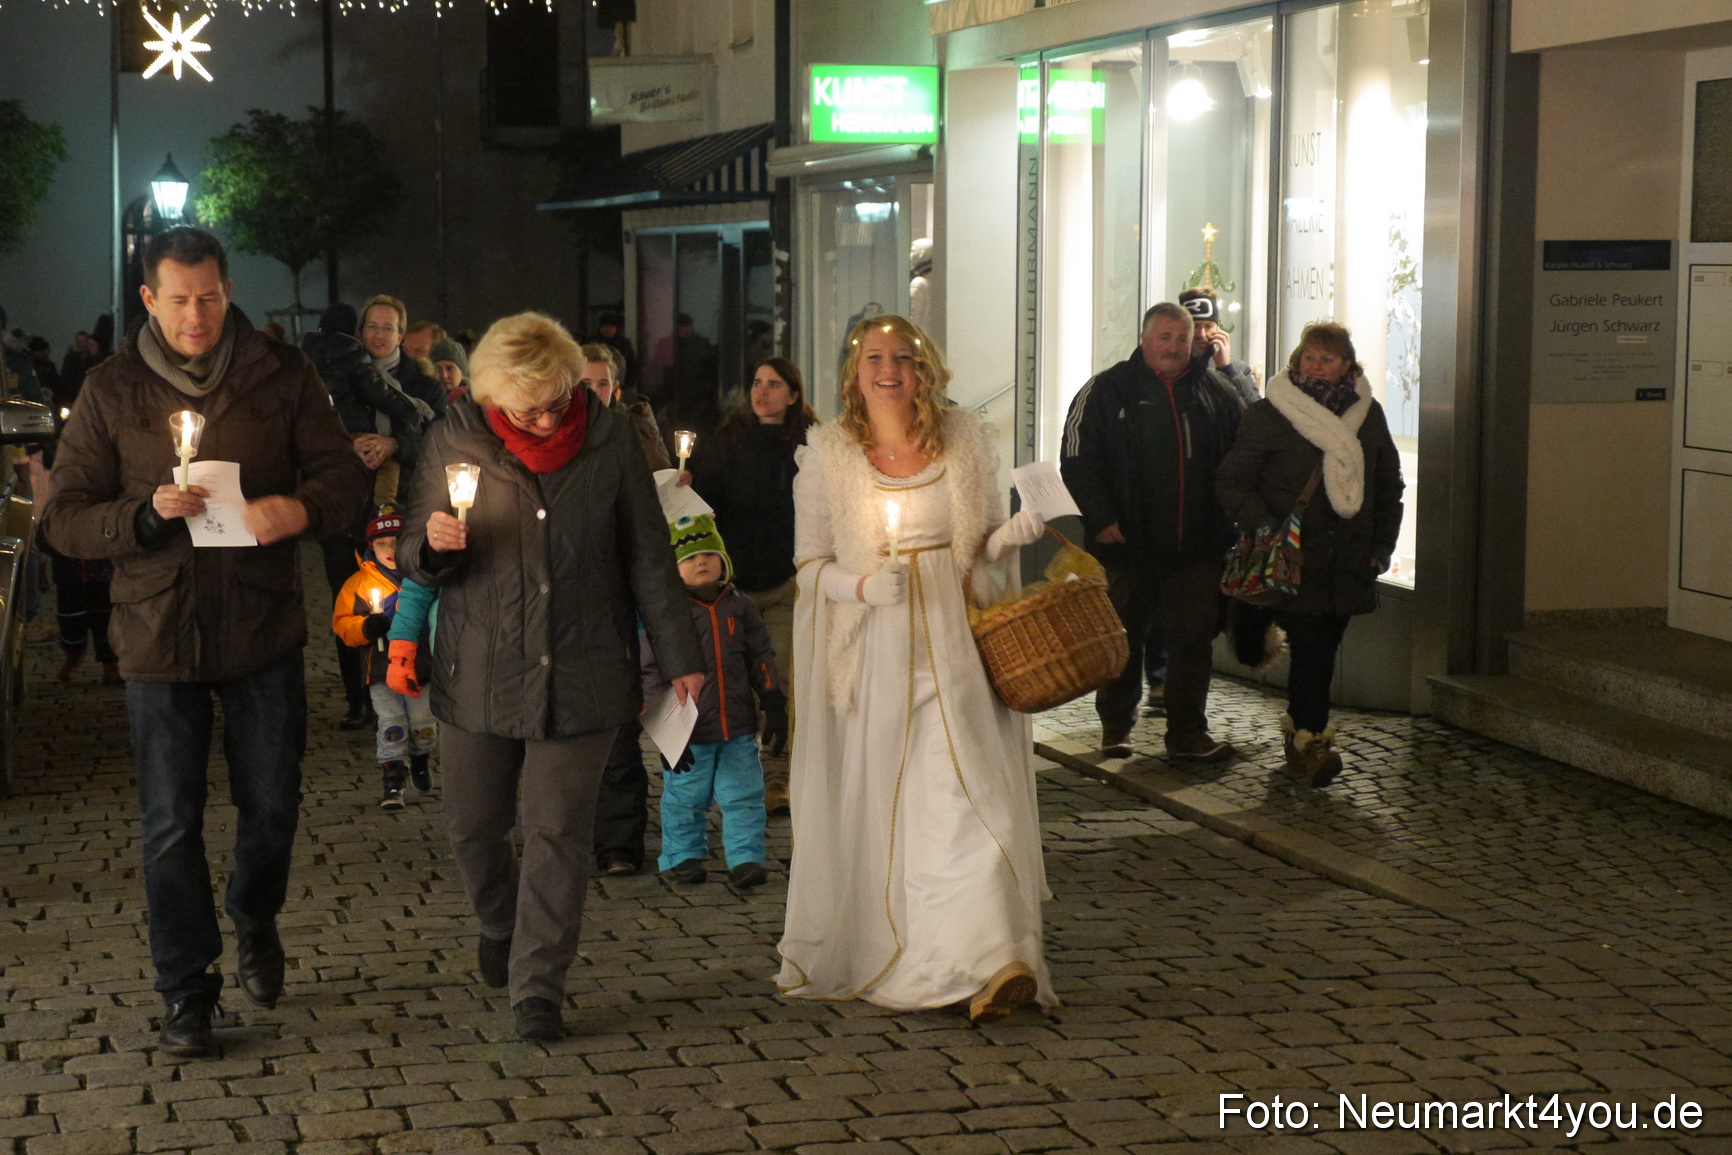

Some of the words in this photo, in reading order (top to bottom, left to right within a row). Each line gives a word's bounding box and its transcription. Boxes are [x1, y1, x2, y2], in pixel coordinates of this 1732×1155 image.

[814, 76, 909, 107] KUNST
[1027, 157, 1037, 334] HERRMANN
[1285, 266, 1325, 300] AHMEN
[1550, 294, 1607, 307] Gabriele
[1612, 293, 1664, 307] Peukert
[1550, 320, 1598, 336] Jürgen
[1603, 319, 1661, 332] Schwarz
[1026, 351, 1036, 447] KUNST
[376, 519, 400, 530] BOB
